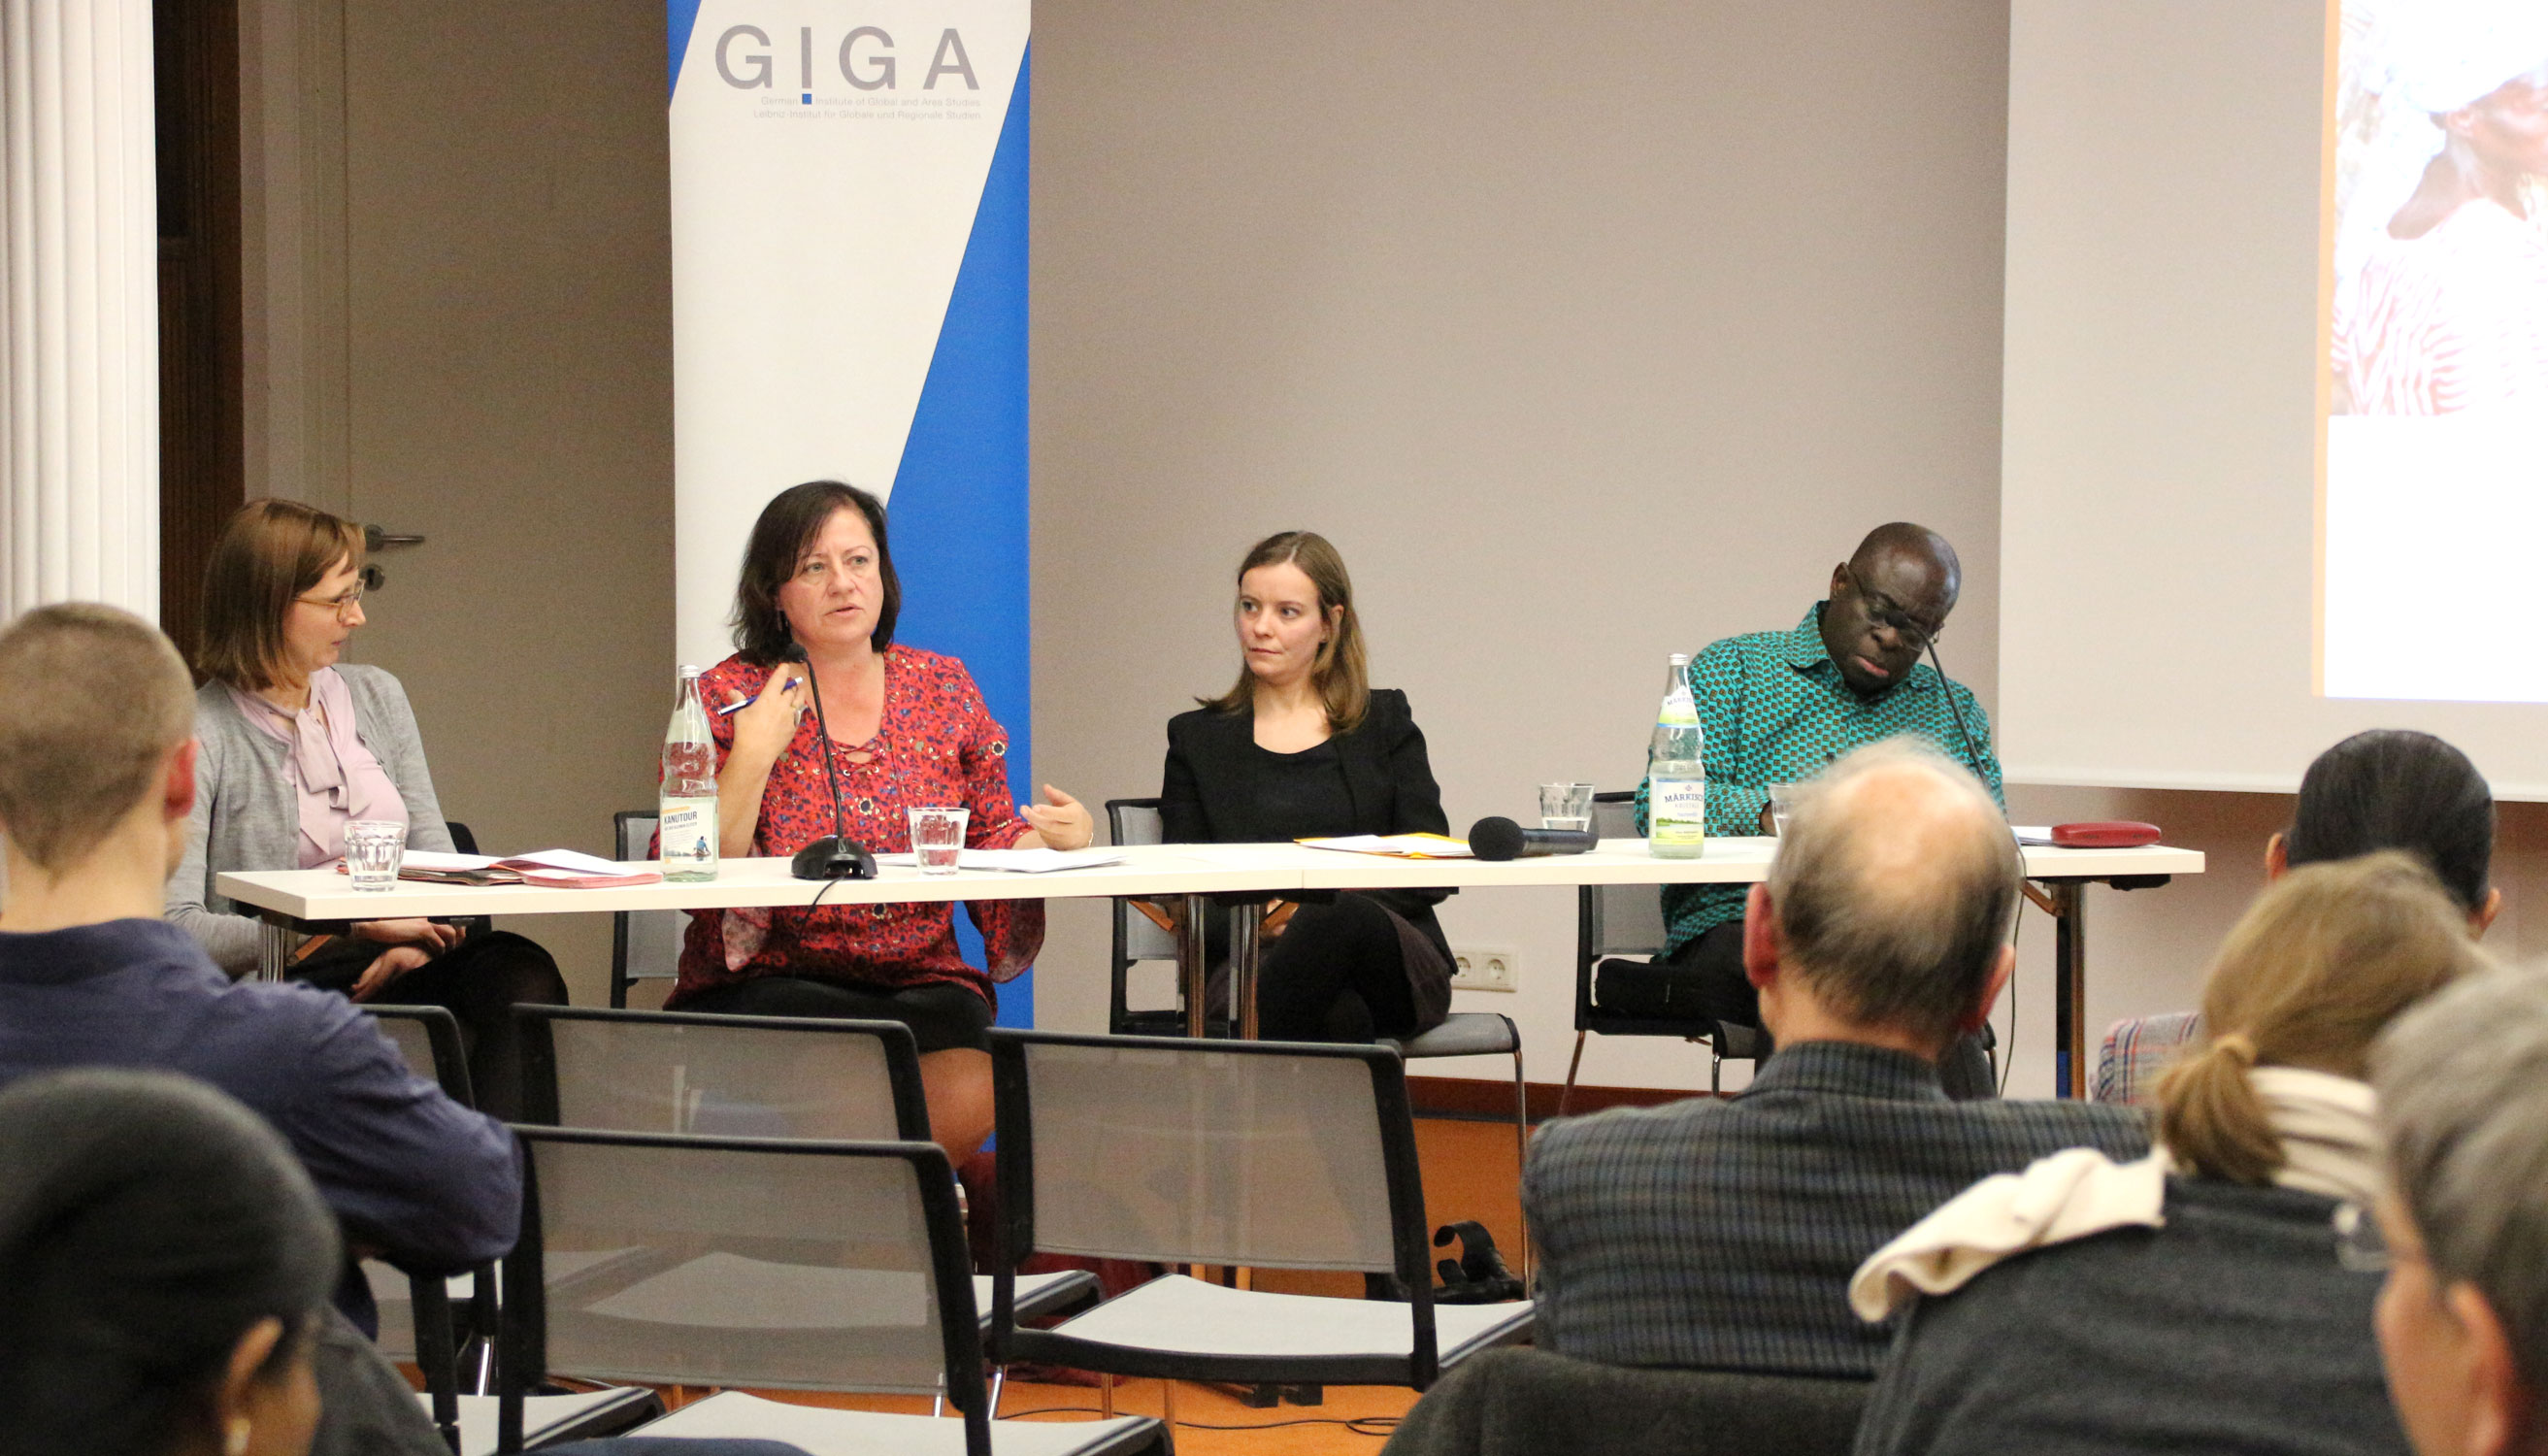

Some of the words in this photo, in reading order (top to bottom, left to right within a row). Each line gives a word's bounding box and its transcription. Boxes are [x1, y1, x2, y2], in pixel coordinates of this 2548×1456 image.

[761, 96, 799, 106] German
[816, 97, 853, 106] Institute
[856, 97, 865, 106] of
[868, 97, 898, 106] Global
[901, 97, 918, 106] and
[922, 98, 943, 107] Area
[945, 97, 980, 107] Studies
[839, 109, 875, 118] Globale
[898, 110, 943, 121] Regionale
[945, 110, 980, 119] Studien
[664, 811, 698, 824] KANUTOUR
